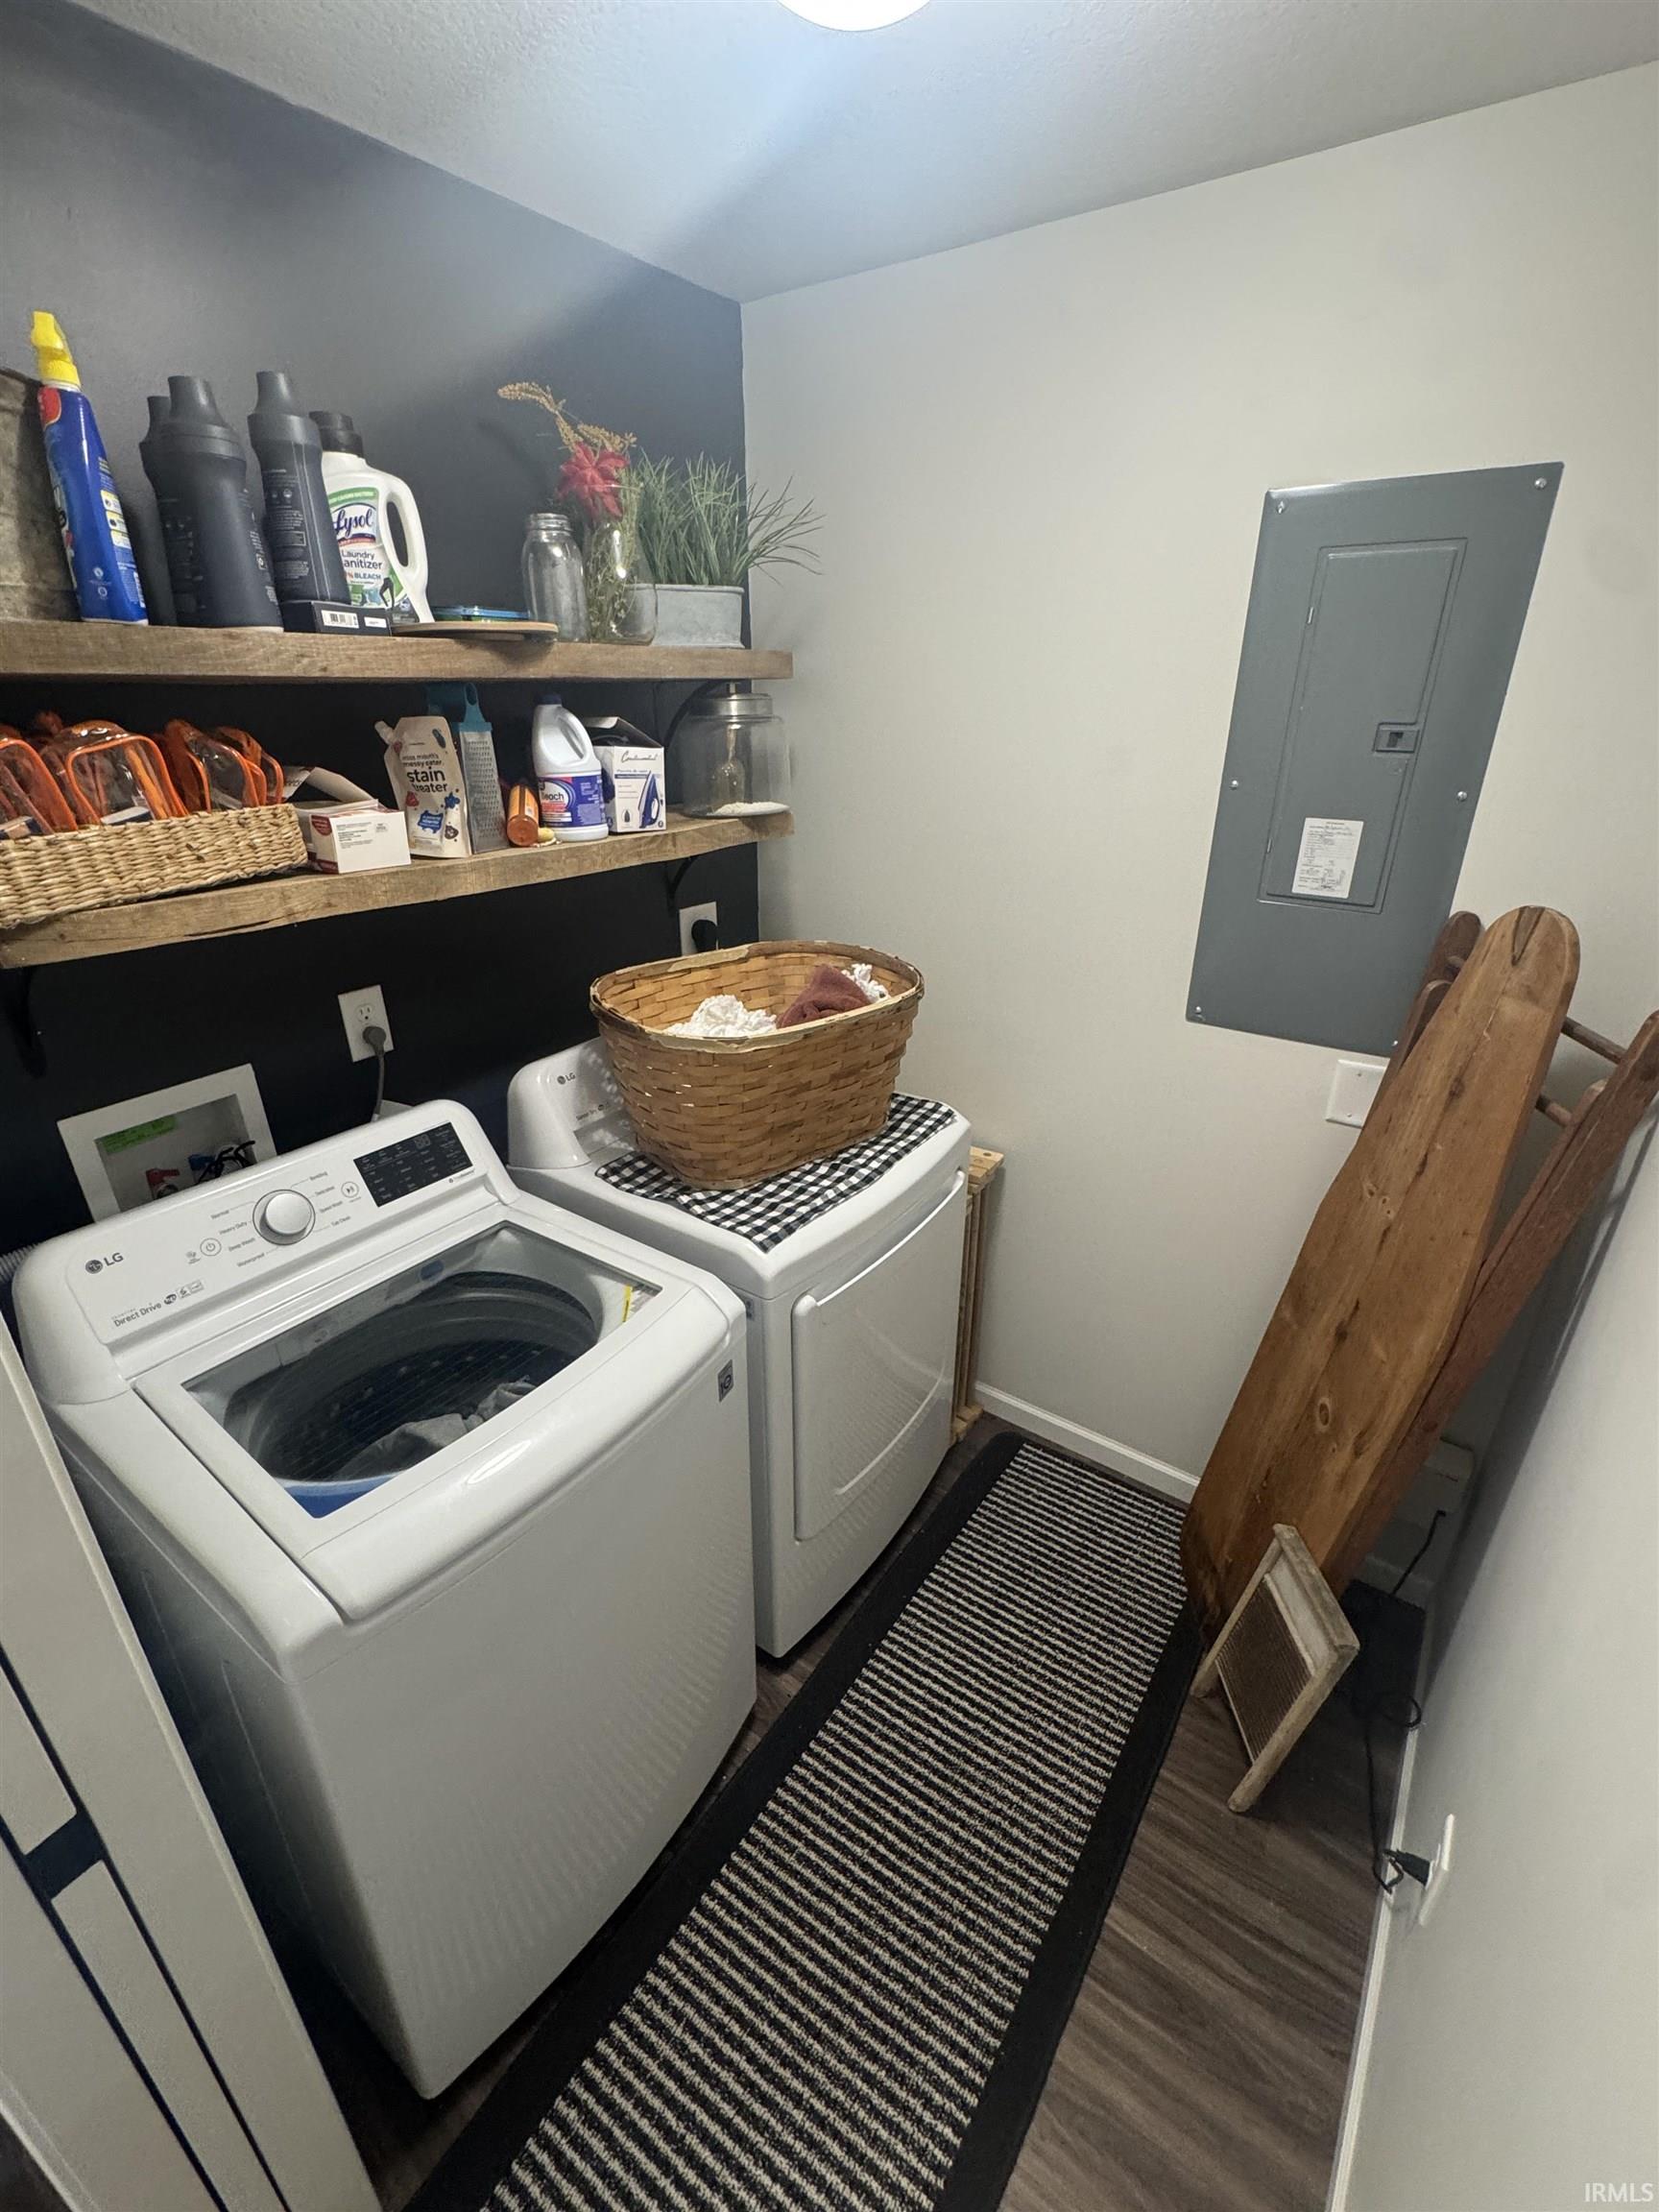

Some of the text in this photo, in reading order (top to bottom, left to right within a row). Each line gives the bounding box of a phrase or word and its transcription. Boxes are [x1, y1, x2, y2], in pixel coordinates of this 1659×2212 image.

[334, 509, 373, 537] Lysol
[341, 549, 375, 560] Laundry
[344, 559, 383, 569] anitizer
[407, 766, 445, 782] stain
[565, 1071, 576, 1082] LG
[104, 1252, 124, 1266] LG
[113, 1310, 140, 1327] Direct
[139, 1301, 162, 1316] Drive
